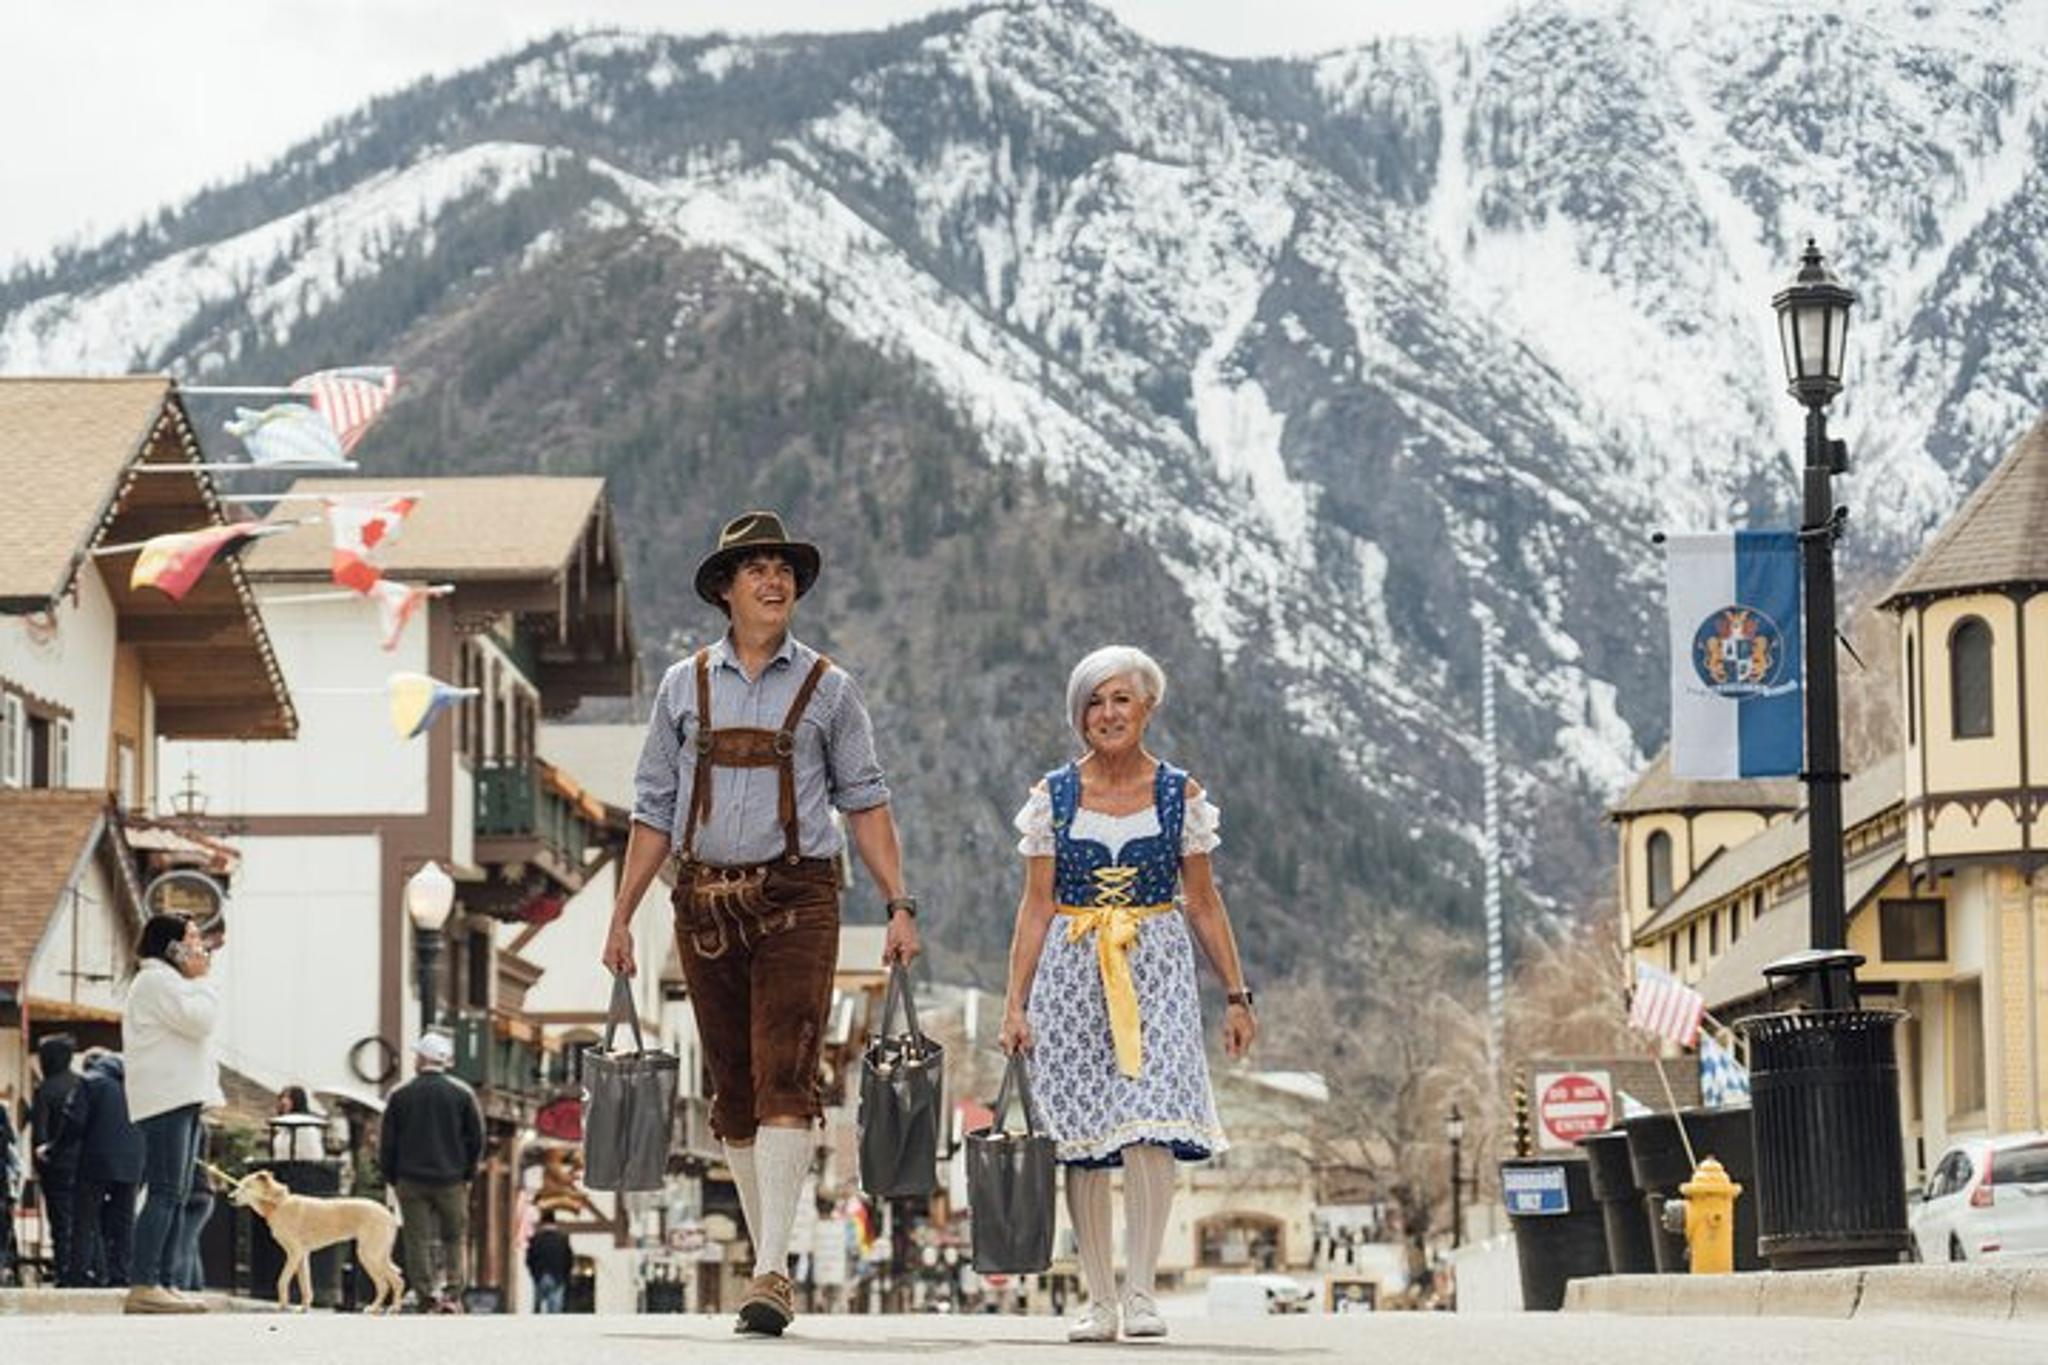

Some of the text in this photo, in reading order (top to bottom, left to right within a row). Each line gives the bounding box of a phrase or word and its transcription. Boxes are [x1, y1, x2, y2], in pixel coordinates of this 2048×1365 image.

[1549, 1085, 1599, 1100] DO NOT
[1554, 1118, 1597, 1133] ENTER
